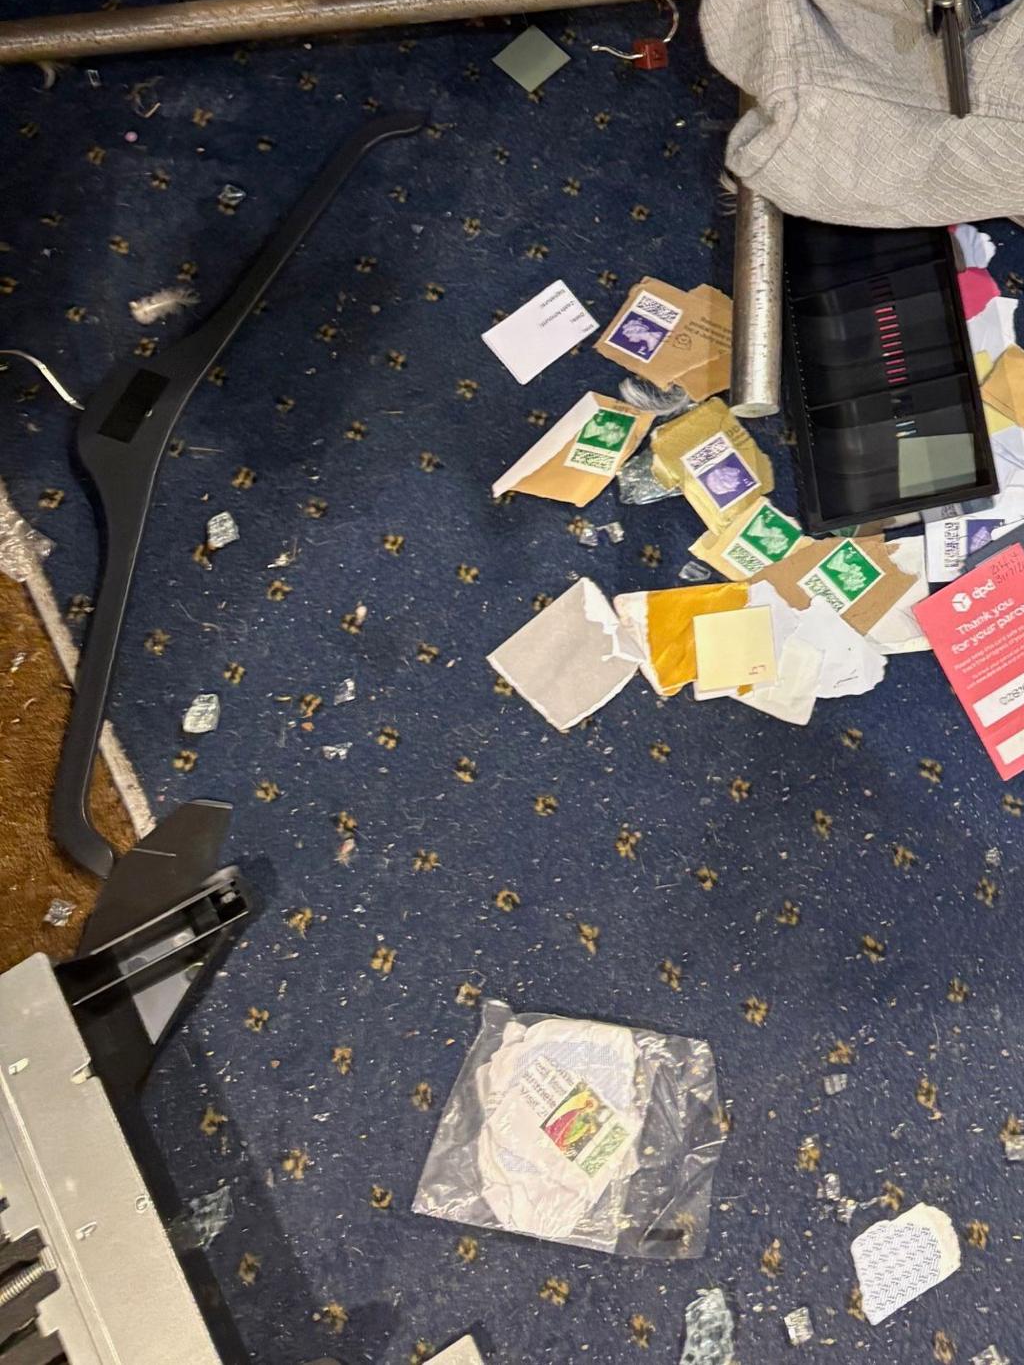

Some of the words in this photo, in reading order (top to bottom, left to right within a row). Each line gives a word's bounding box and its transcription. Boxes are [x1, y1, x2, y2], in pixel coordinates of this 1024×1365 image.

[971, 578, 996, 600] dpd
[955, 611, 993, 635] Thank
[990, 597, 1015, 618] you
[950, 638, 970, 655] for
[969, 622, 996, 646] your
